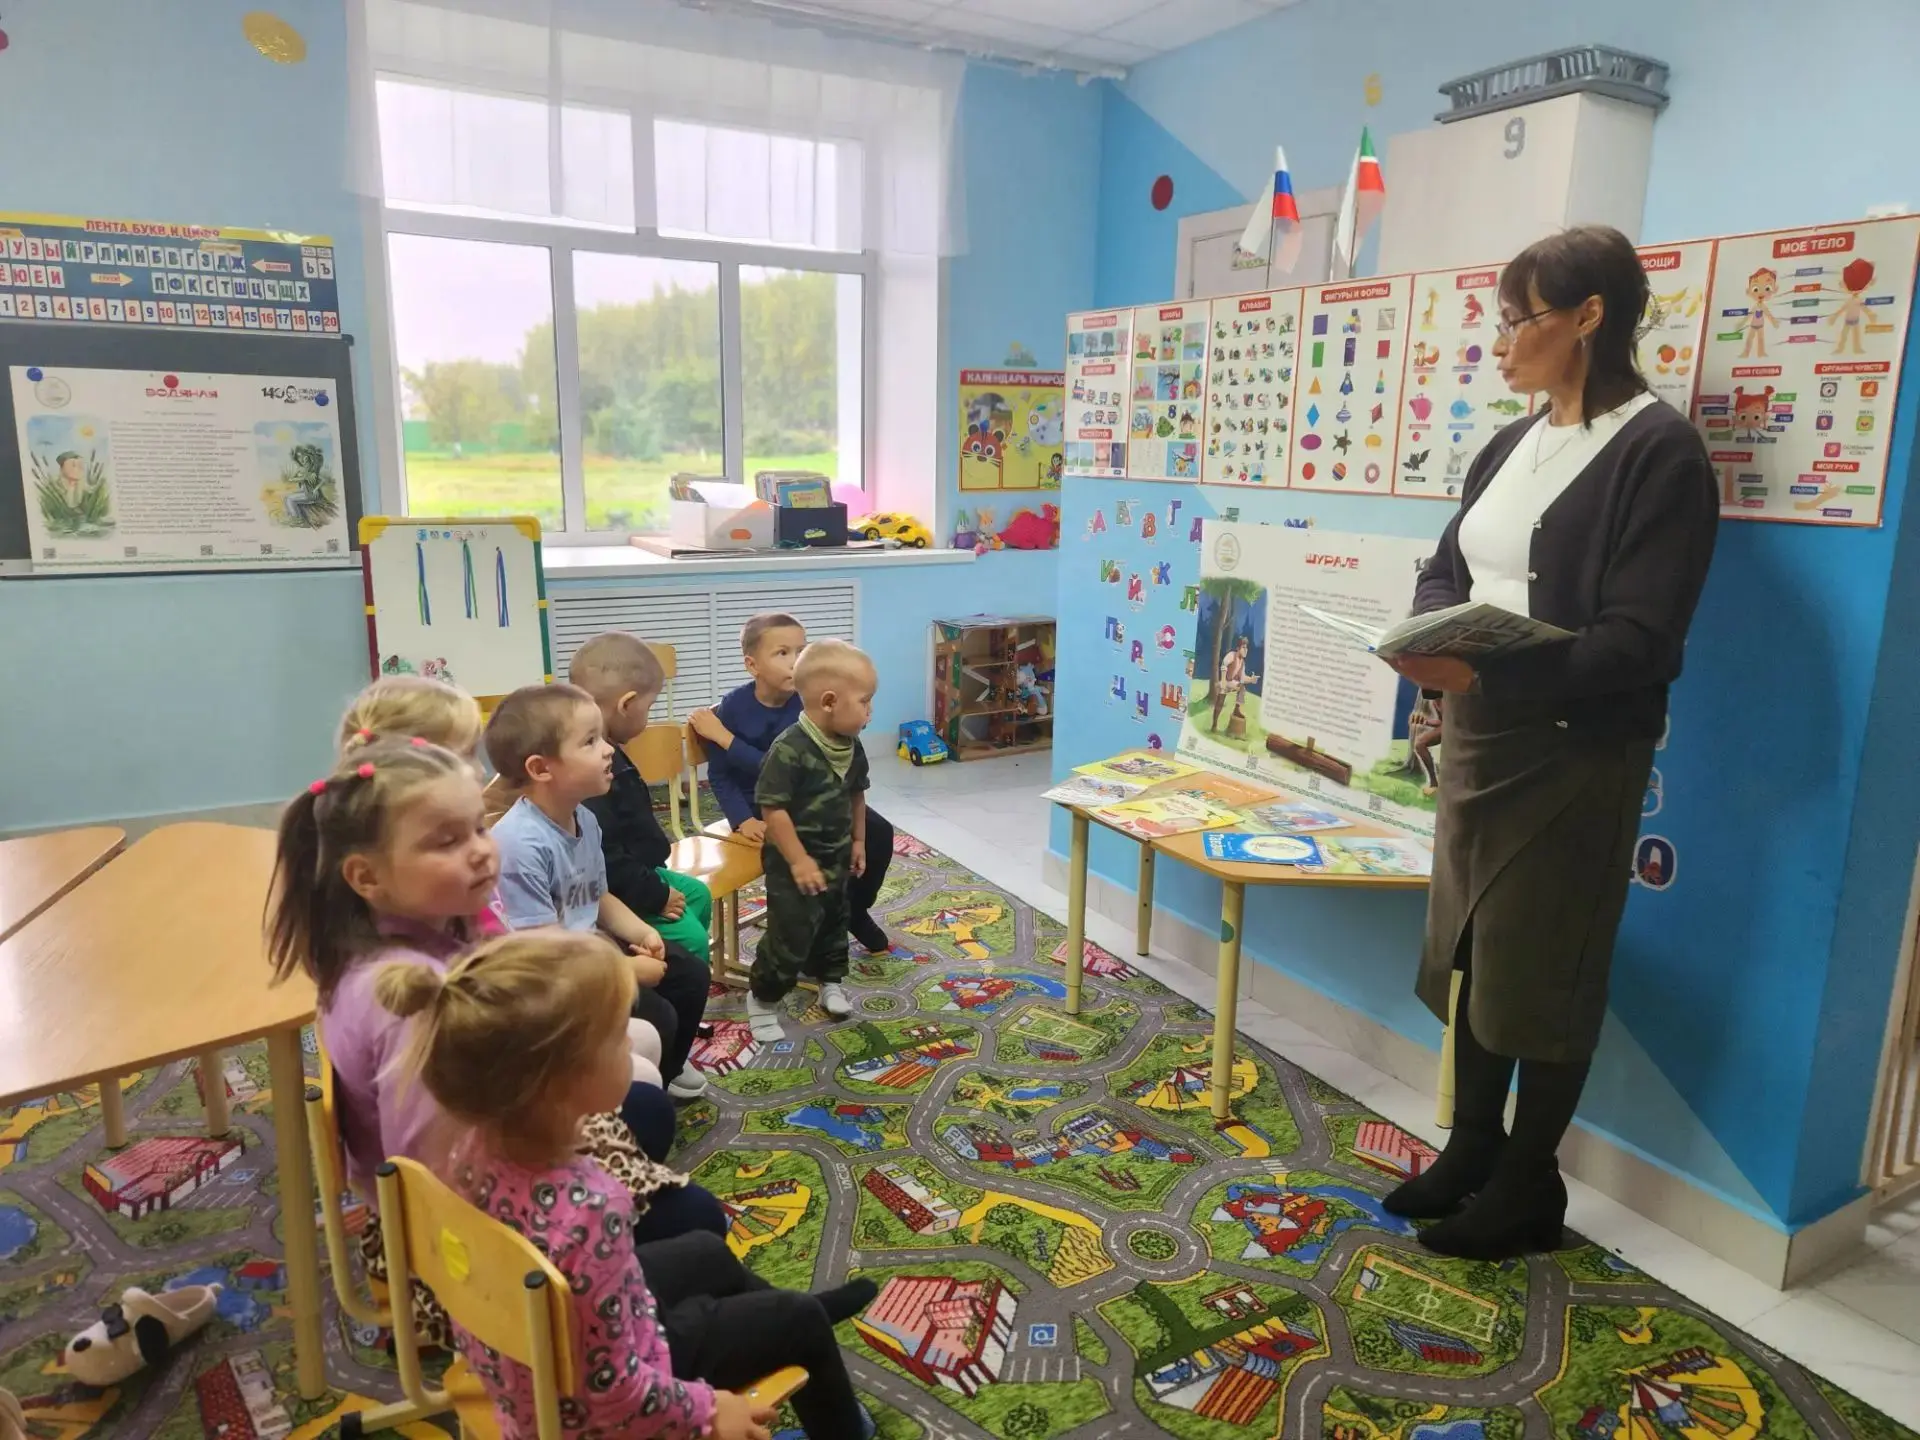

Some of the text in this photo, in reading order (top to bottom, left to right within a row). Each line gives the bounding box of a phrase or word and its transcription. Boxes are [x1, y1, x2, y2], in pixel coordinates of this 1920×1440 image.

[1504, 117, 1525, 159] 9
[86, 220, 128, 233] ЛЕНТА
[132, 223, 165, 235] БУКВ
[1780, 237, 1846, 254] МОЕ ТЕЛО
[1641, 256, 1675, 269] ВОЩИ
[1325, 291, 1353, 301] ФИГУРЫ
[3, 300, 336, 327] 1 2 3 4 5 6 7 8 9 10 11 12 13 14 15 16 17 18 19 20
[1169, 404, 1177, 419] 8
[1093, 510, 1106, 533] А
[1142, 512, 1156, 538] В
[1170, 500, 1182, 525] Г
[1305, 552, 1359, 569] ШУРАЛЕ
[1158, 561, 1171, 585] К
